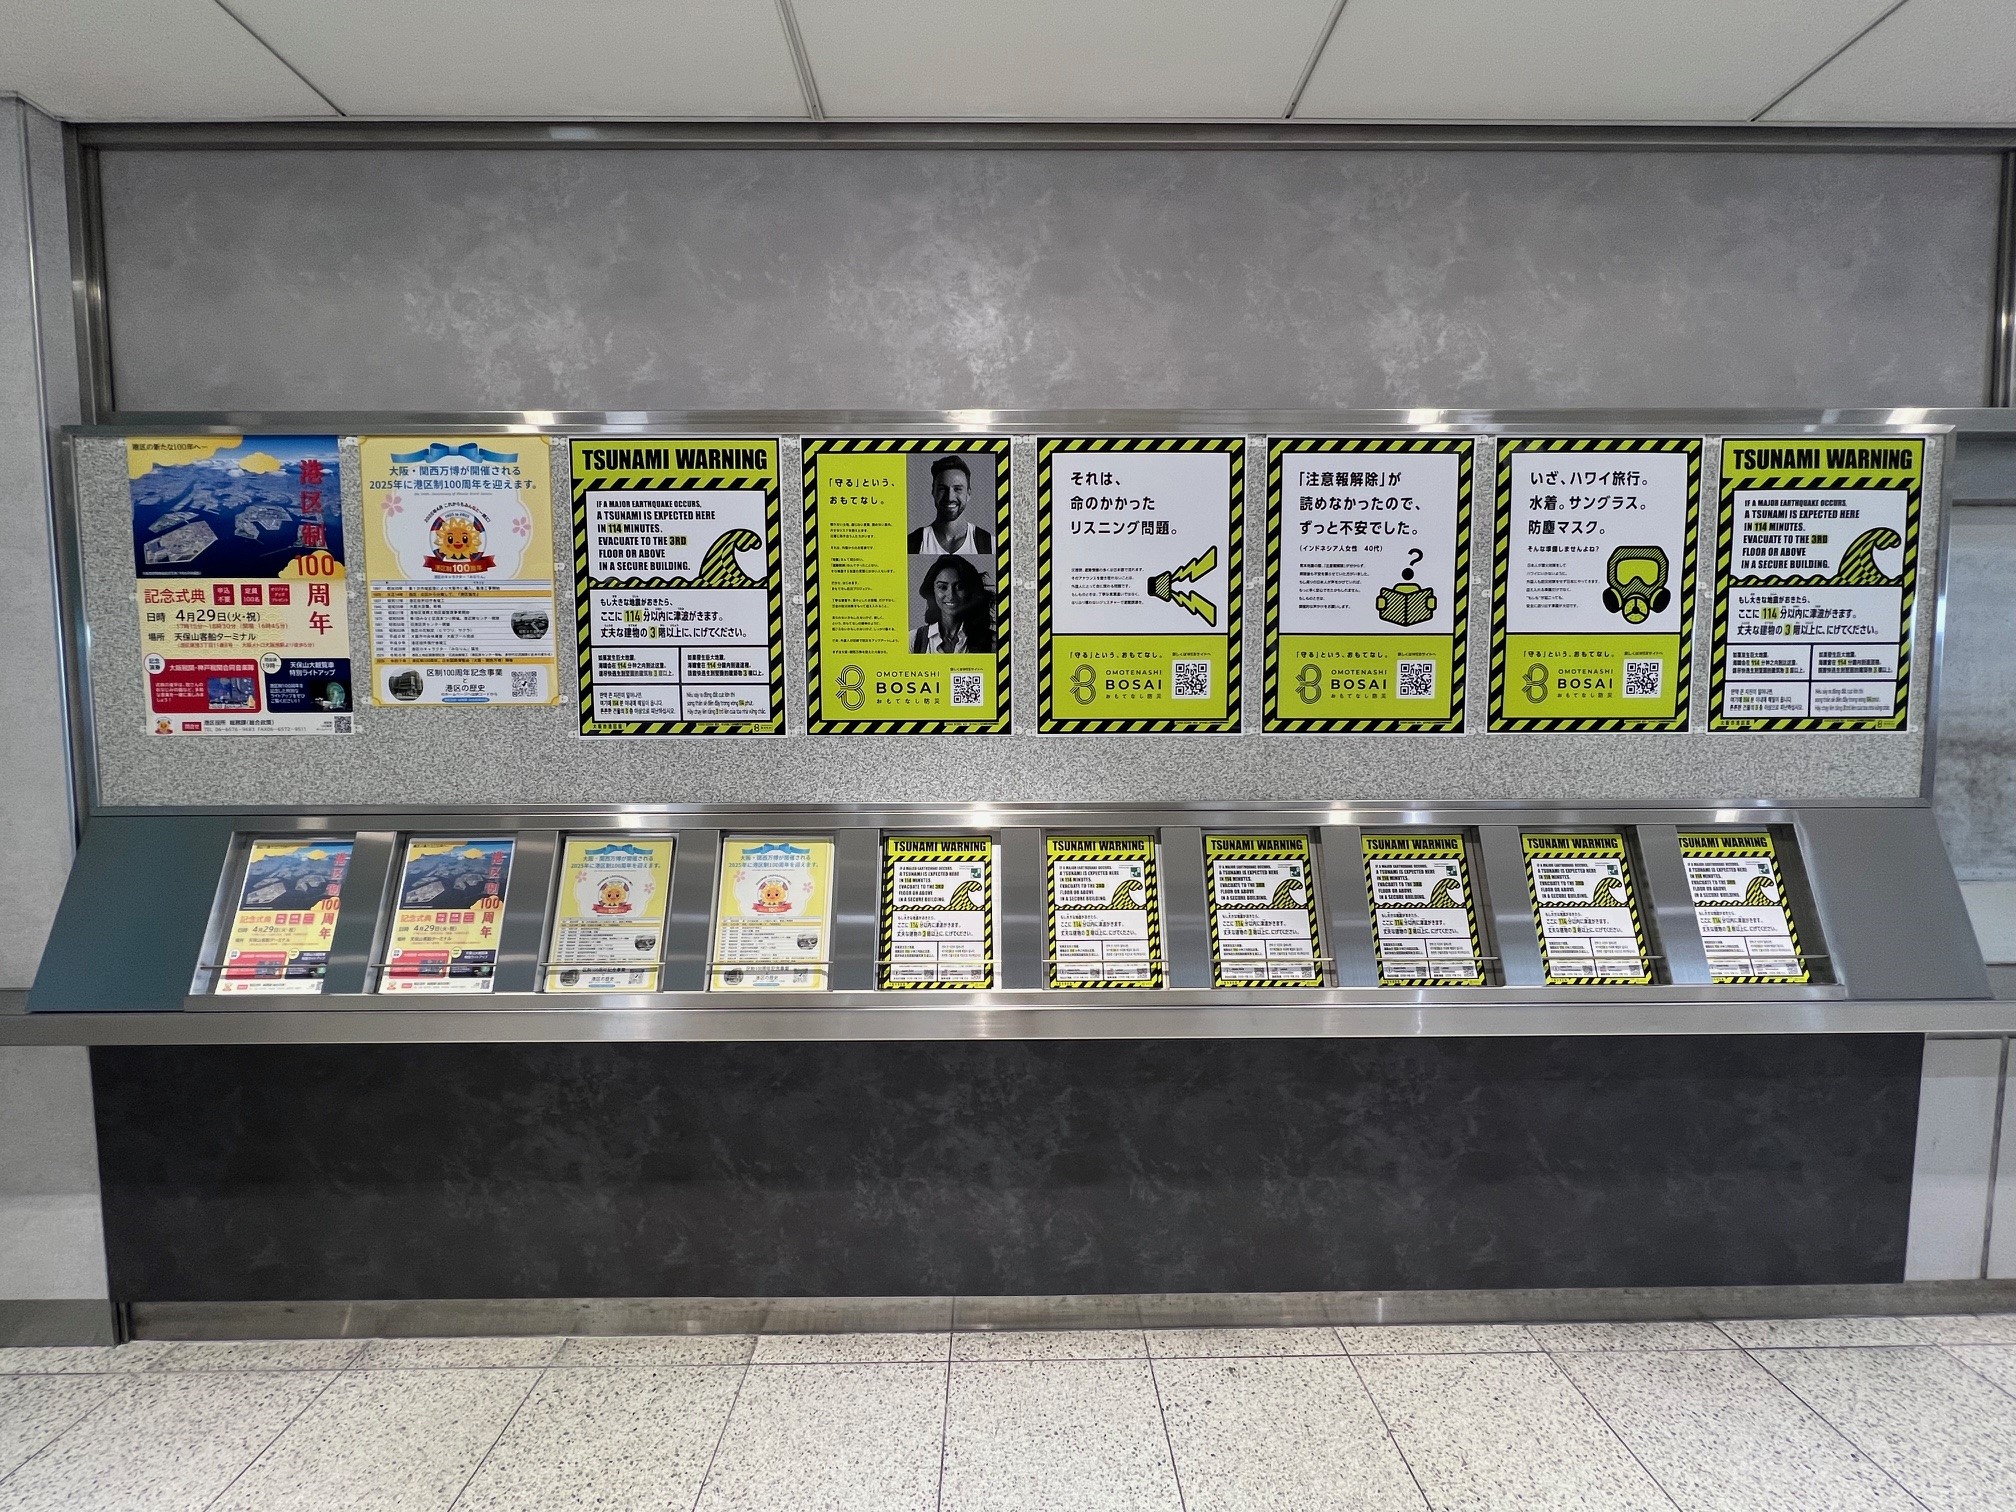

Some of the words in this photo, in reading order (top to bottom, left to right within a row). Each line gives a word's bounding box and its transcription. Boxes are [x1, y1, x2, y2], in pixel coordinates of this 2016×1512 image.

[582, 449, 669, 470] TSUNAMI
[675, 449, 767, 470] WARNING
[1733, 449, 1820, 469] TSUNAMI
[1827, 449, 1912, 469] WARNING
[389, 466, 521, 476] 大阪・関西万博が開催される
[829, 478, 895, 488] 「守る」という、
[1071, 472, 1121, 486] それは、
[1299, 472, 1401, 487] 「注意報解除」が
[1531, 471, 1648, 486] いざ、ハワイ旅行。
[369, 480, 537, 490] 2025年に港区制100周年を迎えます。
[830, 496, 884, 505] おもてなし。
[1071, 496, 1155, 511] 命のかかった
[1300, 496, 1421, 511] 読めなかったので、
[1529, 495, 1646, 511] 水着。サングラス。
[597, 511, 602, 520] A
[604, 511, 641, 520] TSUNAMI
[644, 511, 652, 520] IS
[654, 511, 694, 520] EXPECTED
[696, 511, 715, 520] HERE
[1745, 510, 1750, 519] A
[1752, 510, 1788, 519] TSUNAMI
[1790, 510, 1797, 518] IS
[1799, 510, 1838, 518] EXPECTED
[1840, 510, 1860, 518] HERE
[598, 524, 606, 533] IN
[608, 524, 622, 533] 114
[624, 524, 663, 533] MINUTES.
[1071, 521, 1178, 535] リスニング問題。
[1300, 521, 1418, 535] ずっと不安でした。
[1528, 520, 1606, 535] 防塵マスク。
[1744, 523, 1752, 531] IN
[1755, 522, 1767, 531] 114
[1769, 522, 1805, 531] MINUTES.
[599, 537, 639, 545] EVACUATE
[641, 537, 651, 545] TO
[653, 537, 668, 545] THE
[670, 537, 687, 545] 3RD
[1743, 535, 1782, 544] EVACUATE
[1784, 535, 1794, 544] TO
[1795, 535, 1810, 544] THE
[1811, 535, 1828, 544] 3RD
[599, 550, 624, 558] FLOOR
[626, 550, 637, 558] OR
[639, 550, 665, 558] ABOVE
[1742, 548, 1766, 556] FLOOR
[1768, 548, 1779, 556] OR
[1780, 548, 1806, 556] ABOVE
[599, 562, 607, 571] IN
[610, 562, 615, 571] A
[617, 562, 648, 571] SECURE
[650, 562, 690, 571] BUILDING.
[1741, 560, 1750, 568] IN
[1751, 560, 1757, 568] A
[1758, 560, 1788, 568] SECURE
[1790, 560, 1830, 569] BUILDING.
[144, 589, 205, 604] 記念式典
[147, 613, 165, 622] 日時
[601, 612, 622, 621] ここに
[626, 611, 641, 622] 114
[149, 633, 165, 641] 場所
[174, 633, 256, 641] 天保山客船ターミナル
[650, 627, 656, 638] 3
[427, 669, 503, 677] 区制100周年記念事業
[877, 682, 940, 694] BOSAI
[1106, 680, 1162, 690] BOSAI
[1332, 679, 1387, 690] BOSAI
[1558, 678, 1613, 689] BOSAI
[894, 841, 937, 852] TSUNAMI
[941, 841, 986, 852] WARNING
[1053, 841, 1095, 851] TSUNAMI
[1099, 841, 1144, 851] WARNING
[1211, 840, 1254, 851] TSUNAMI
[1257, 840, 1303, 851] WARNING
[1367, 839, 1409, 850] TSUNAMI
[1412, 839, 1458, 850] WARNING
[1527, 838, 1570, 849] TSUNAMI
[1572, 838, 1618, 849] WARNING
[1722, 838, 1768, 848] WARNING
